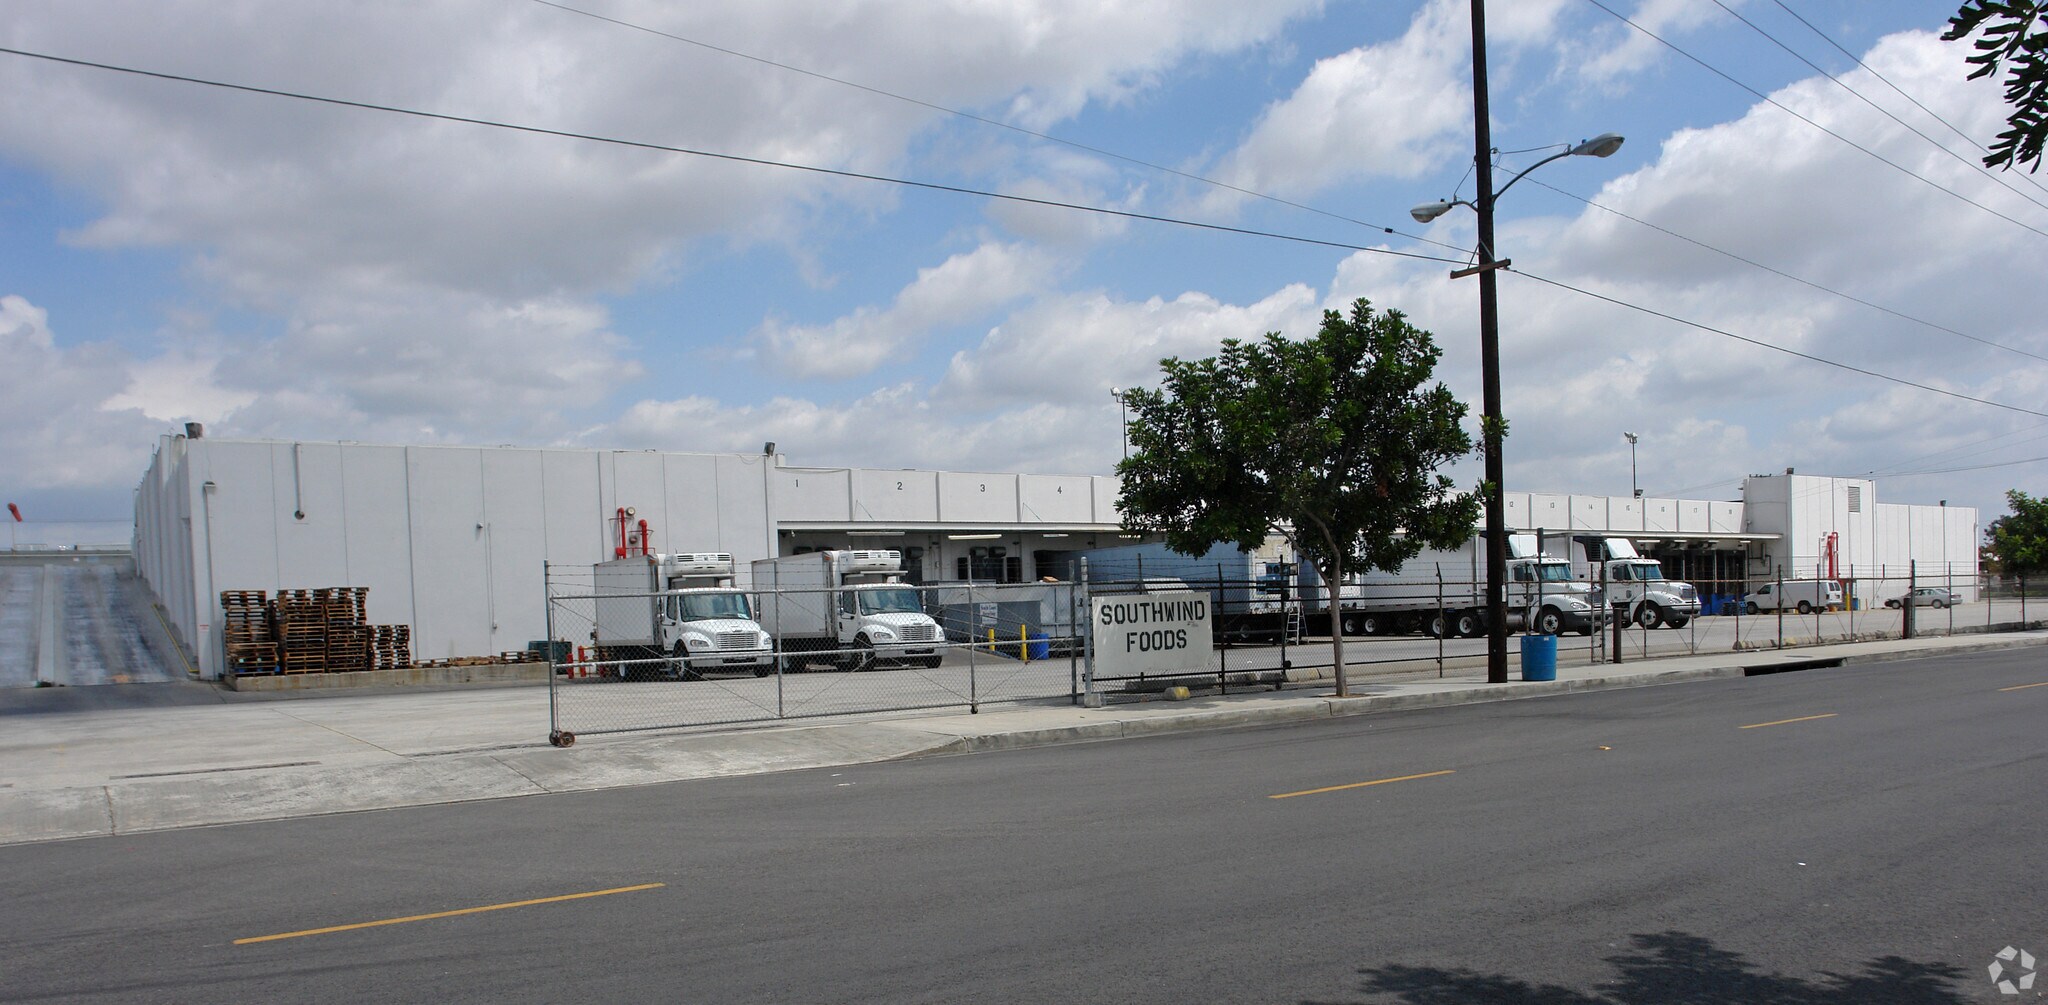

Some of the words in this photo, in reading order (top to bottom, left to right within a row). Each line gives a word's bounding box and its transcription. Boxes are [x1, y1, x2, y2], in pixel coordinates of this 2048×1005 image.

[896, 482, 903, 490] 2
[980, 484, 986, 492] 3
[1057, 486, 1062, 494] 4
[1101, 600, 1205, 625] SOUTHWIND
[1127, 629, 1187, 652] FOODS
